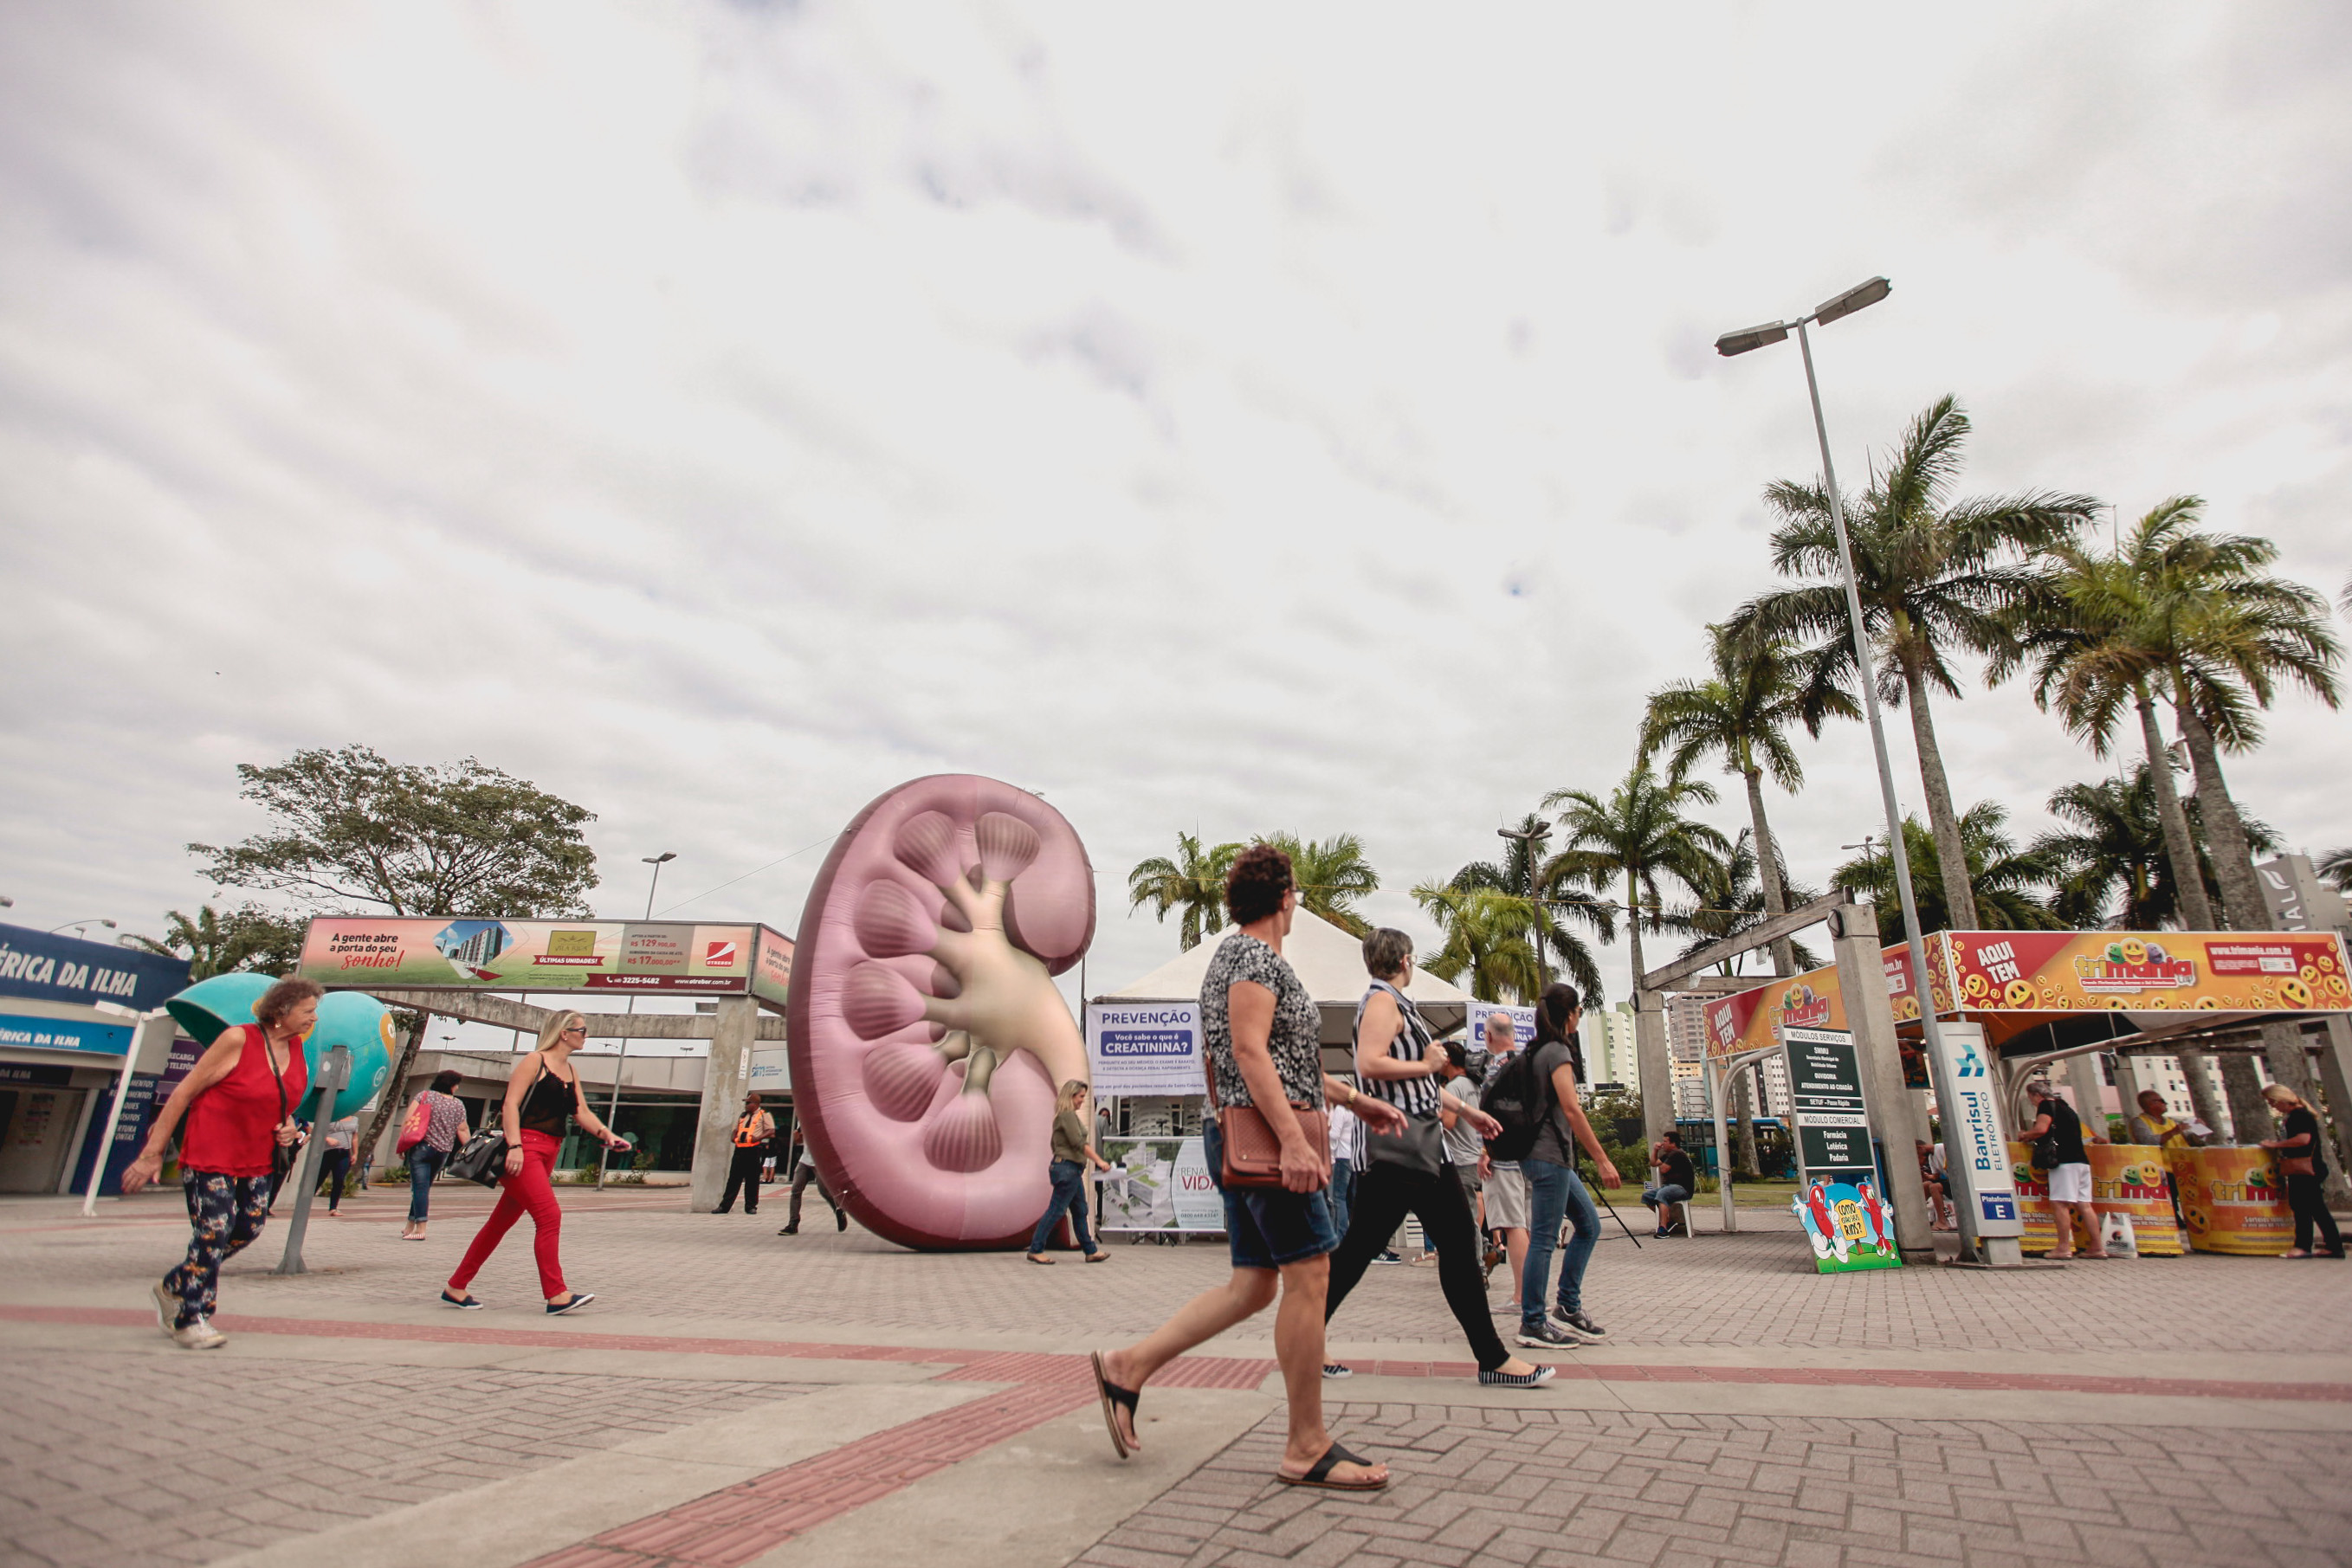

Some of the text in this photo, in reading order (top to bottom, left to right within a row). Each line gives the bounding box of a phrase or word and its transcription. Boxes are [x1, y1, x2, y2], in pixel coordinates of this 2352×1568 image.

[333, 933, 398, 944] A gente abre
[641, 939, 677, 948] 129.900,00
[337, 945, 364, 953] porta
[1976, 940, 2016, 967] AQUI
[340, 950, 405, 971] sonho!
[2074, 954, 2194, 978] trimania
[56, 961, 90, 990] DA
[90, 968, 139, 997] ILHA
[1987, 961, 2021, 984] TEM
[1102, 1010, 1192, 1027] PREVENÇÃO
[1714, 1003, 1734, 1029] AQUI
[1768, 996, 1829, 1026] trimania
[34, 1032, 53, 1046] DA
[54, 1036, 81, 1048] ILHA
[1718, 1022, 1735, 1047] TEM
[1790, 1030, 1819, 1041] MÓDULOS
[1819, 1033, 1846, 1043] SERVIÇOS
[1105, 1042, 1188, 1054] CREATININA?
[1804, 1115, 1861, 1125] MÓDULO COMERCIAL
[1960, 1092, 1991, 1171] Banrisul
[1980, 1092, 2003, 1171] ELETRÔNICO
[1826, 1142, 1848, 1151] Lotérica
[1829, 1153, 1849, 1162] Padaria
[1838, 1203, 1856, 1216] COMO
[1994, 1204, 2006, 1218] E
[1844, 1222, 1863, 1236] RINS?
